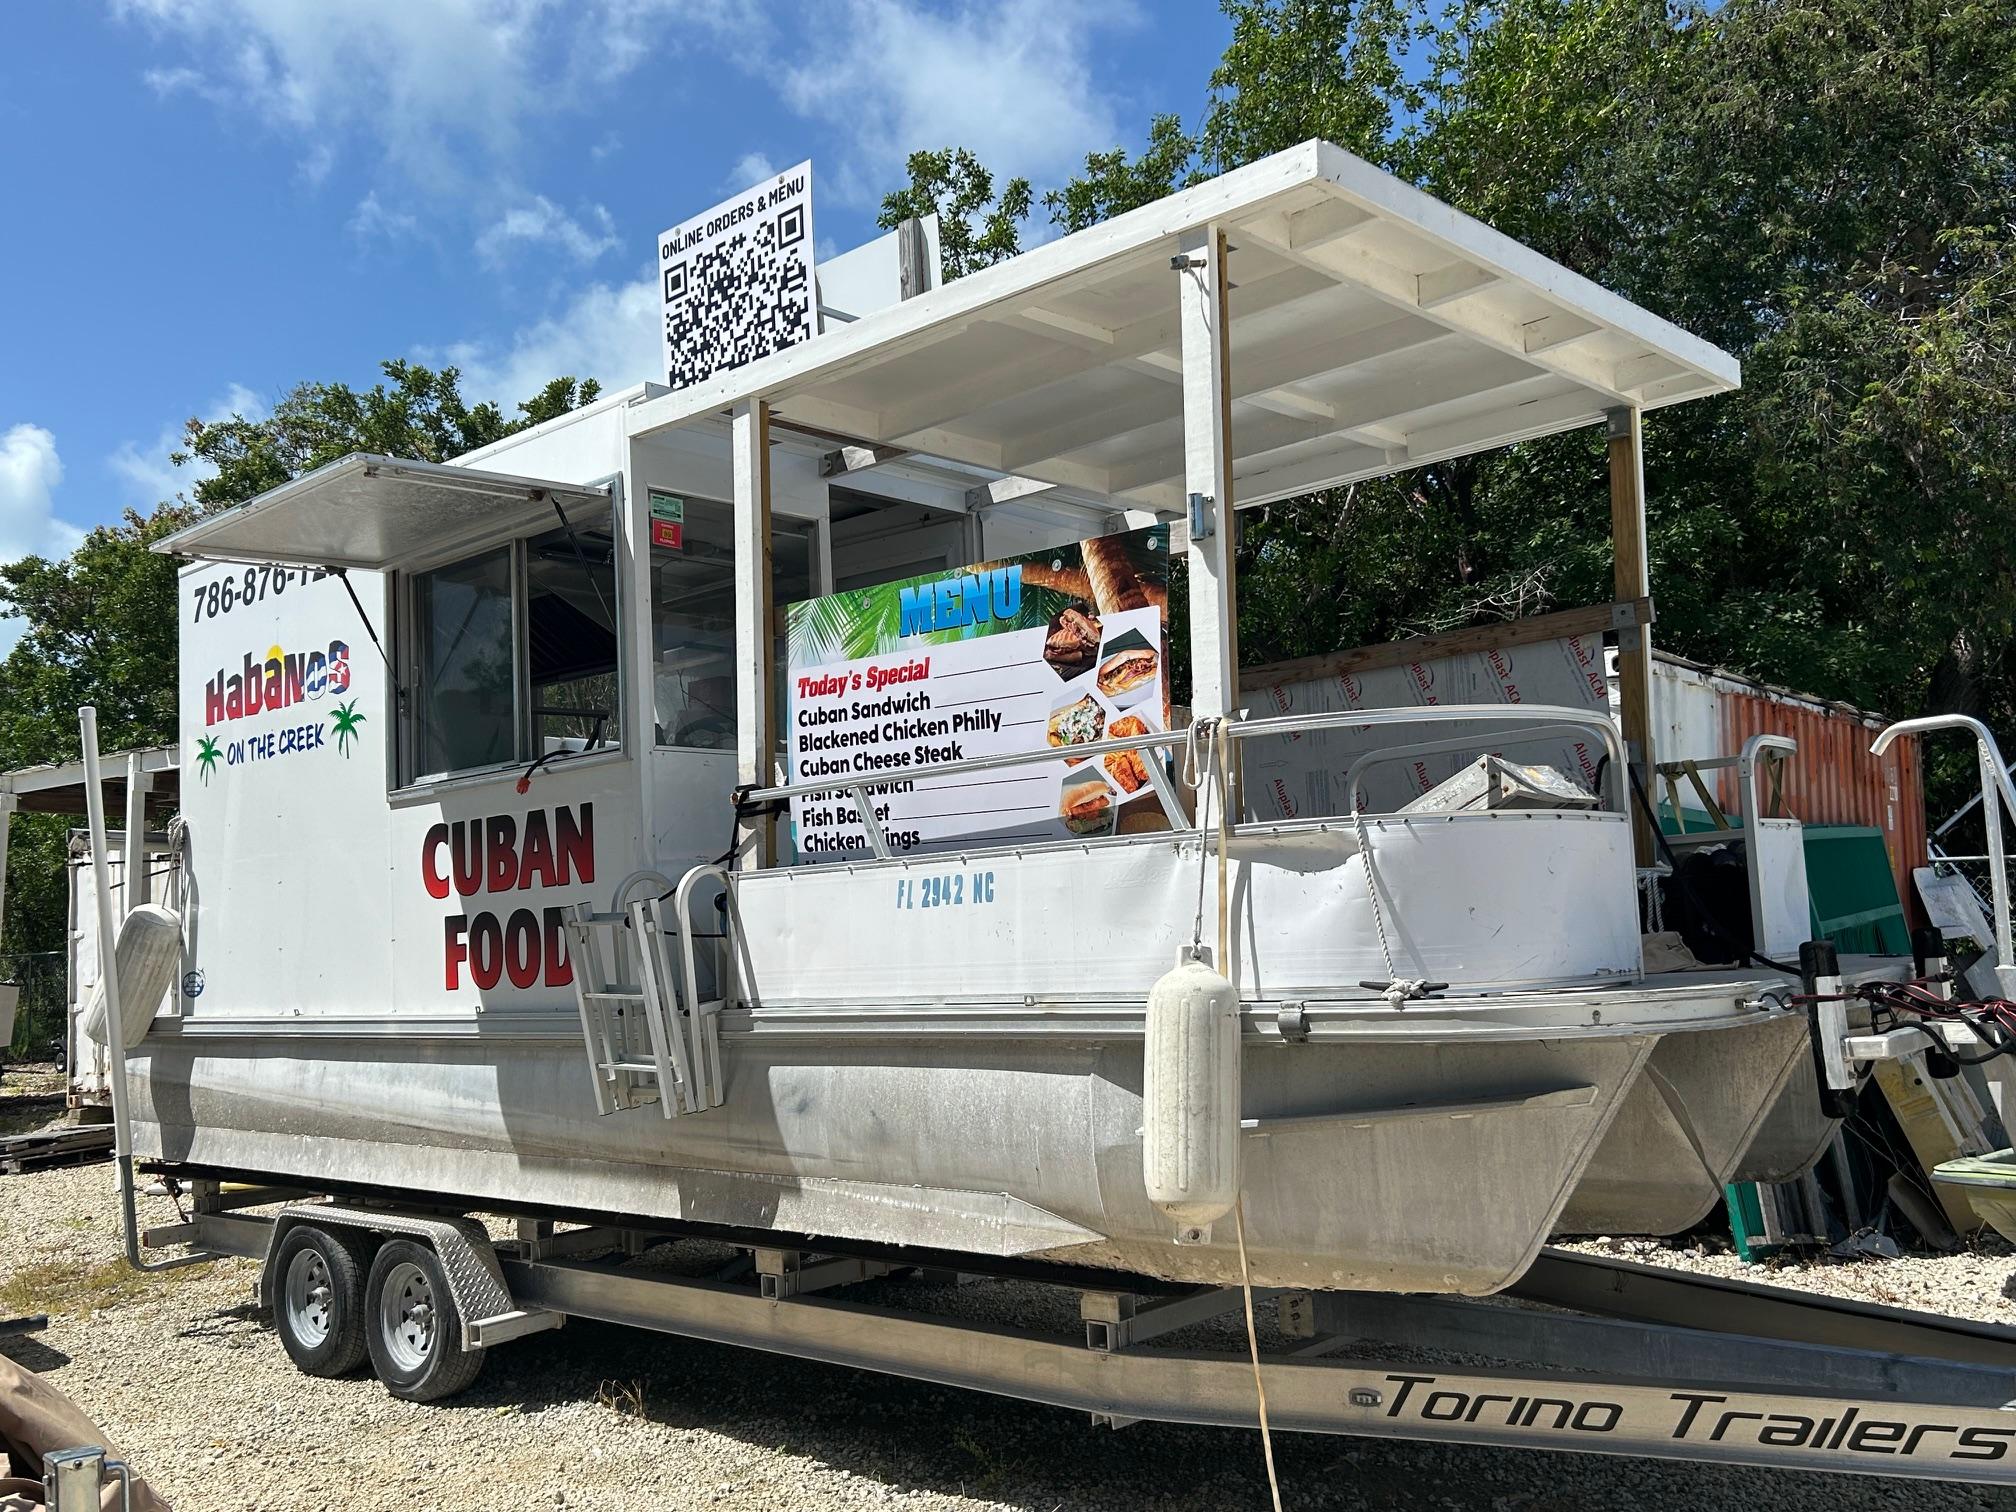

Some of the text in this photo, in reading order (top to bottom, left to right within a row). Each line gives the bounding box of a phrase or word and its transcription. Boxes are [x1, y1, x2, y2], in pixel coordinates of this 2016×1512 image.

[662, 175, 805, 260] ONLINE ORDERS & MENU
[900, 565, 1022, 638] MENU
[798, 657, 930, 699] Today's Special
[1586, 671, 1607, 699] ACM
[798, 691, 931, 727] Cuban Sandwich
[799, 708, 1002, 752] Blackened Chicken Philly
[227, 723, 324, 766] ON THE CREEK
[800, 741, 963, 777] Cuban Cheese Steak
[1573, 742, 1597, 785] Aluplas
[1413, 761, 1434, 793] Alupl
[802, 803, 890, 827] Fish Baet
[422, 802, 595, 899] CUBAN
[804, 826, 920, 852] Chicken ings
[897, 871, 994, 909] FL 2942 NC
[444, 907, 574, 991] FOOD
[1384, 1375, 2016, 1460] Torino Trailers
